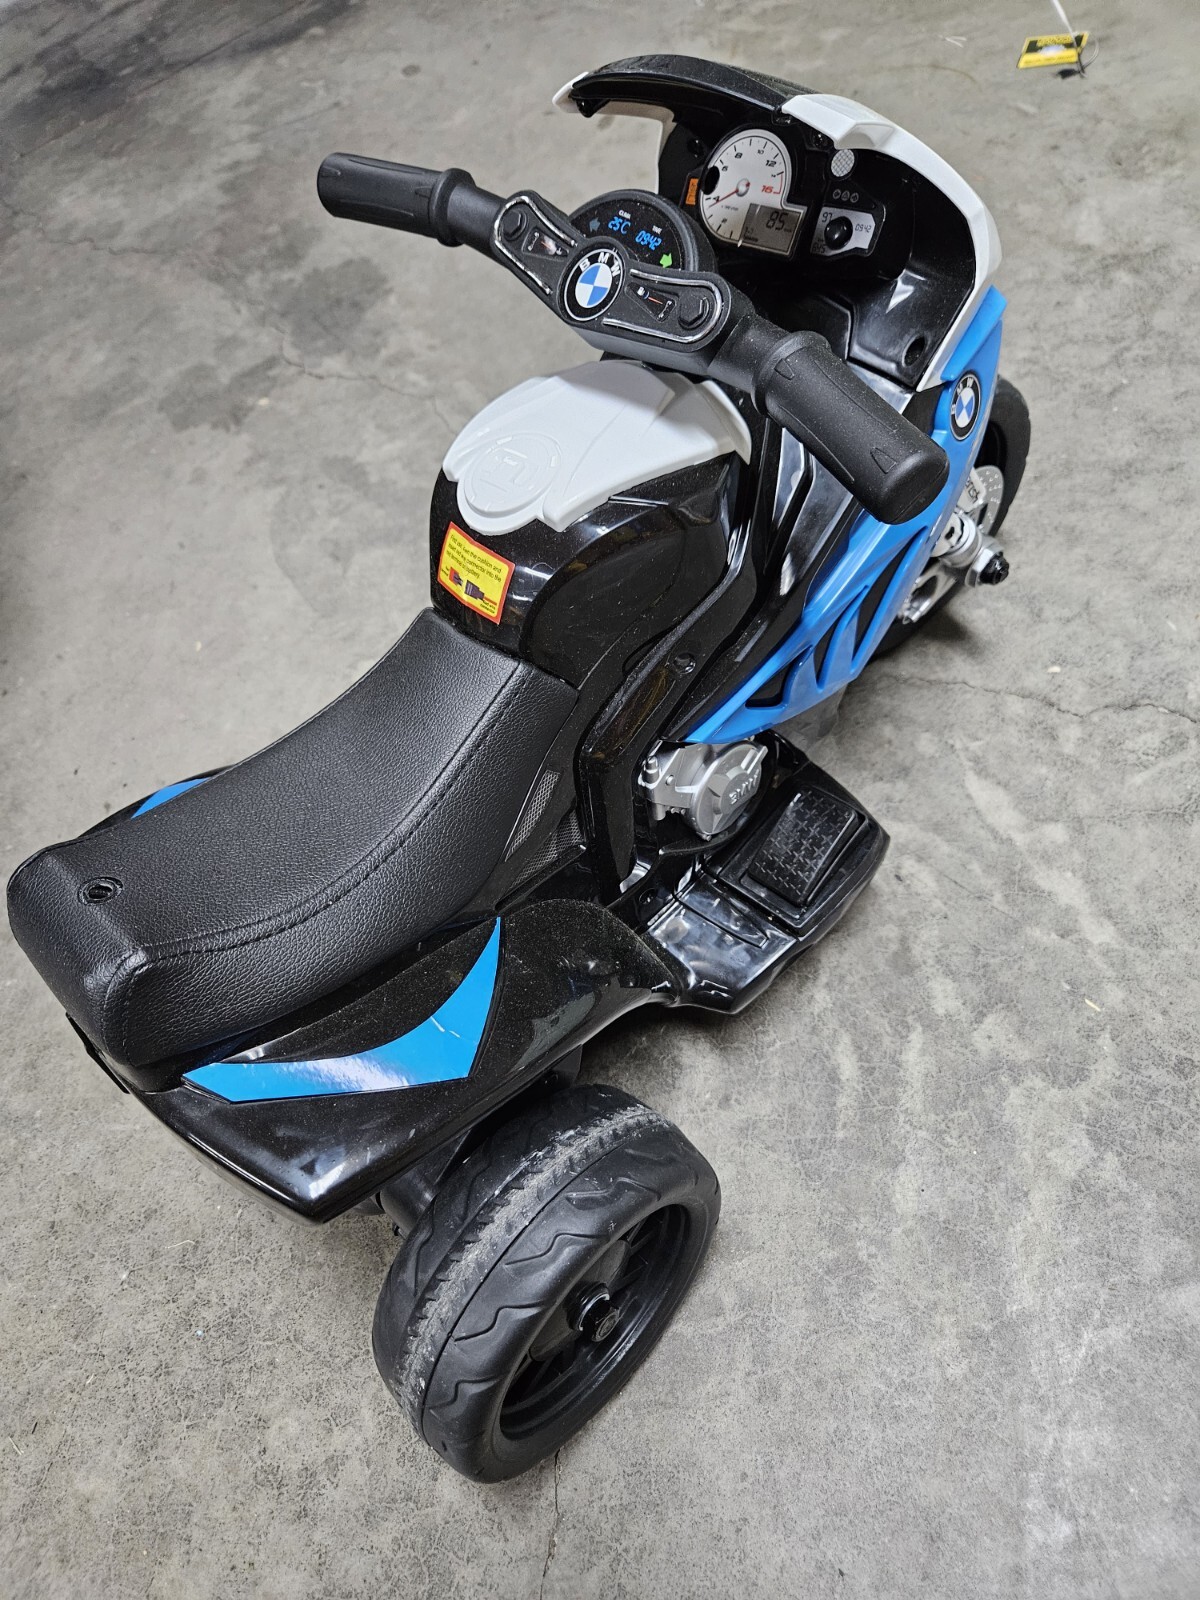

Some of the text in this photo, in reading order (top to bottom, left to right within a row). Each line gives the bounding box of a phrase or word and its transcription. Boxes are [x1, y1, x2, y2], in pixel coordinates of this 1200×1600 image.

[761, 184, 773, 194] 16
[765, 210, 789, 230] 85
[579, 251, 621, 278] BMW
[951, 377, 974, 415] BMW
